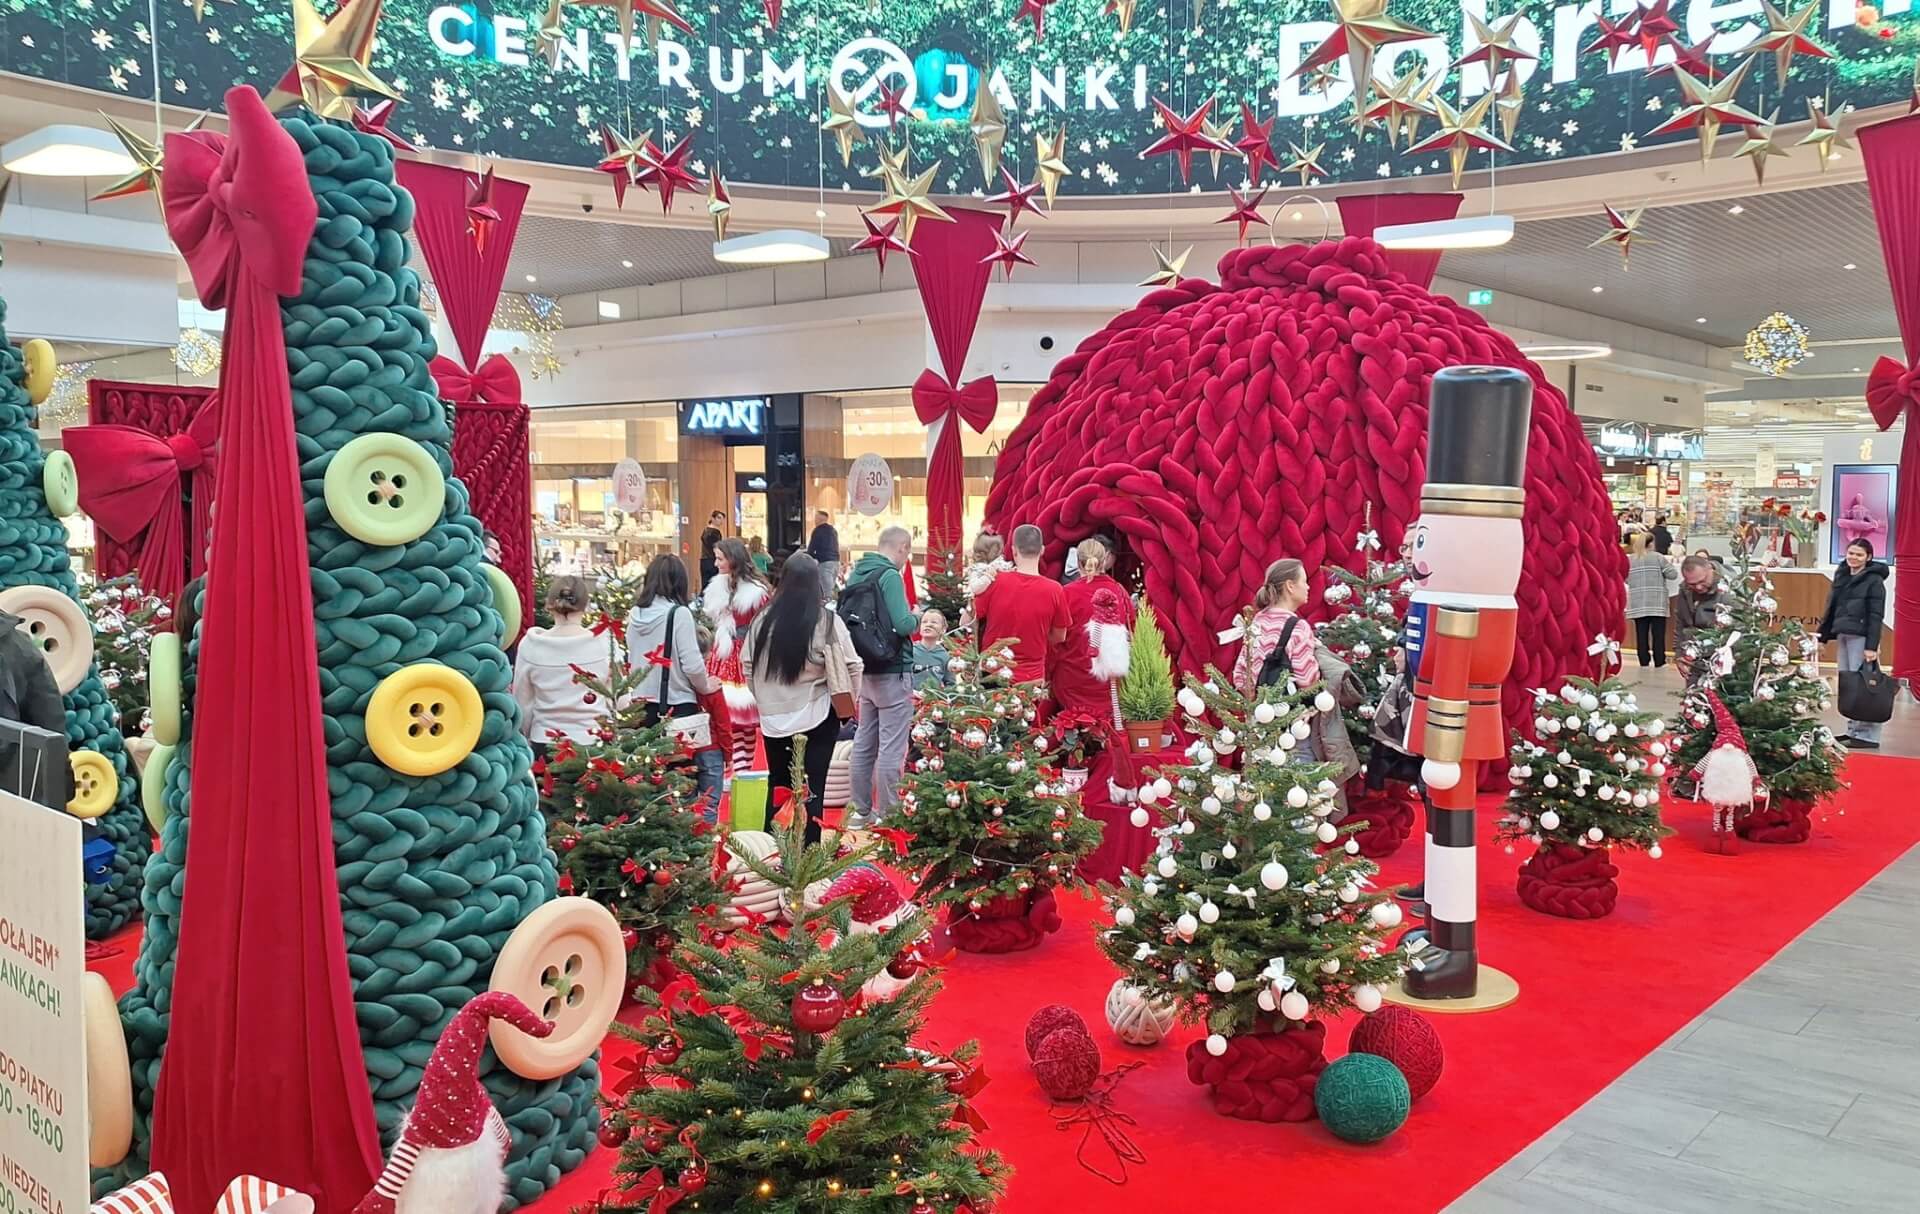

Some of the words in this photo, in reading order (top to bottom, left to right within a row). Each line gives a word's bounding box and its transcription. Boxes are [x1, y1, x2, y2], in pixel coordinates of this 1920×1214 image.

[428, 5, 806, 100] CENTRUM
[935, 64, 1147, 112] JANKI
[687, 399, 764, 434] APART
[0, 957, 60, 1018] ANKACH!
[0, 1050, 16, 1082] DO
[20, 1065, 63, 1116] PIĄTKU
[26, 1103, 63, 1153] 19:00
[2, 1153, 63, 1214] NIEDZIELA
